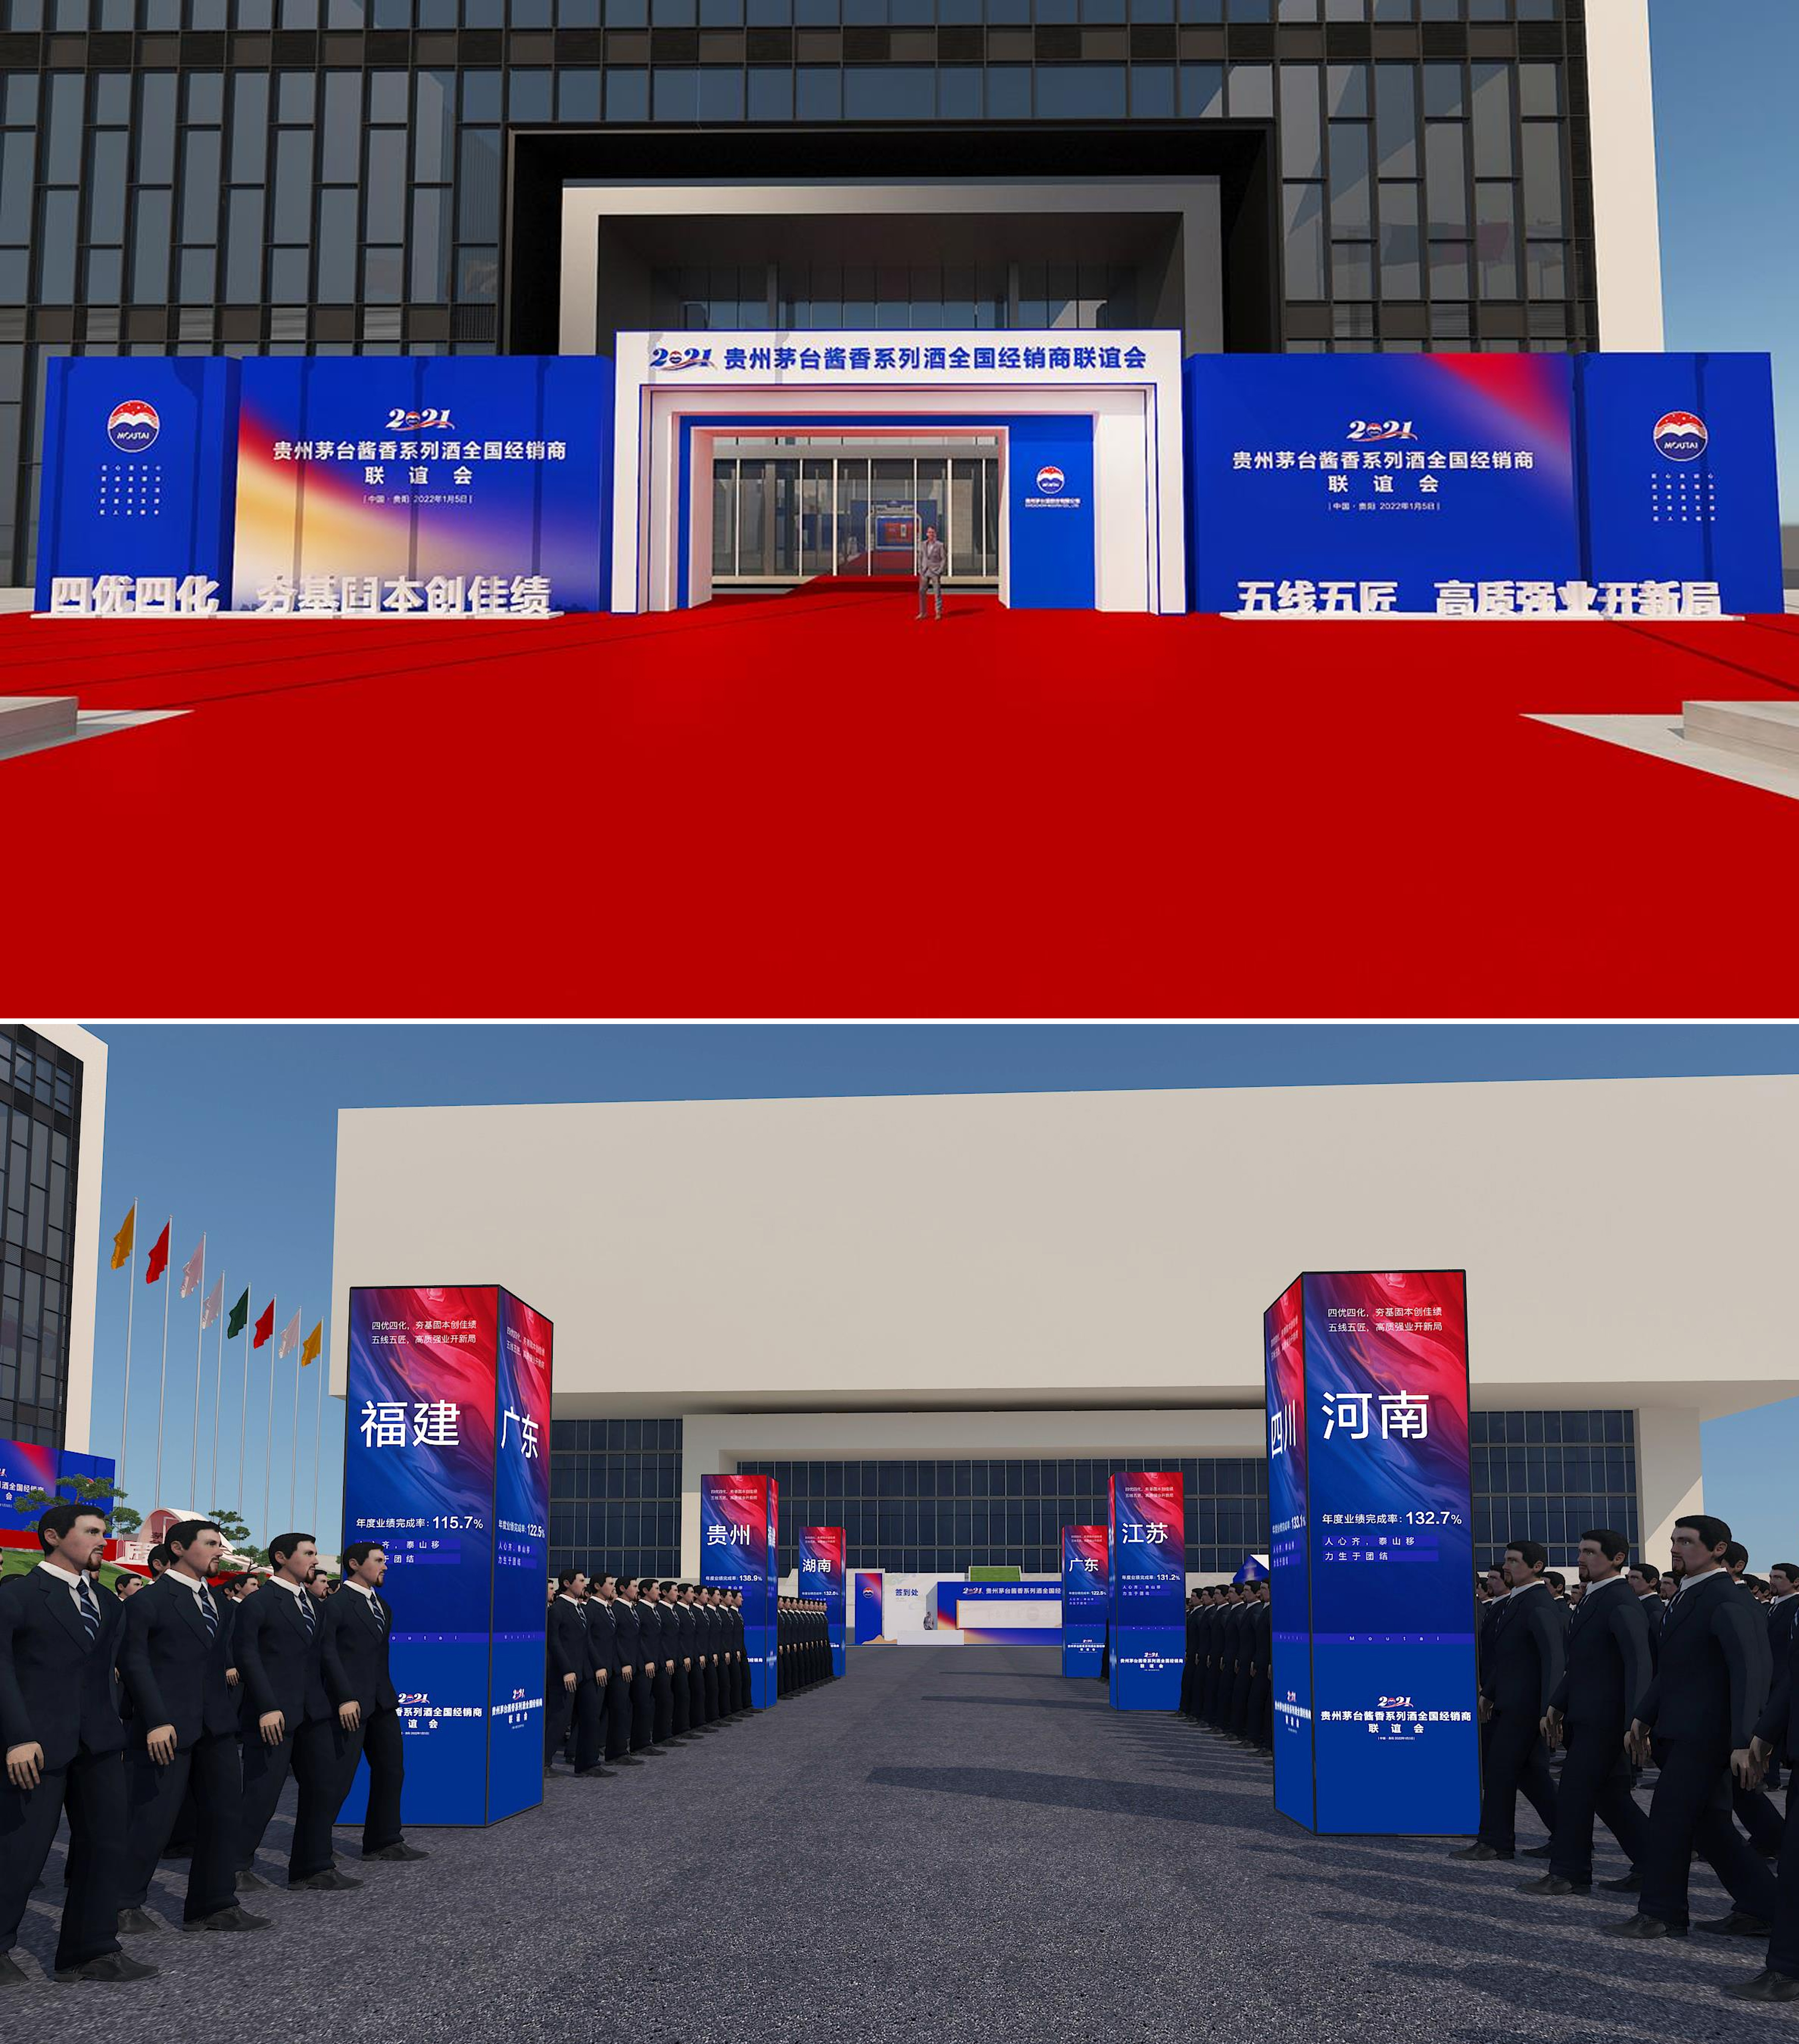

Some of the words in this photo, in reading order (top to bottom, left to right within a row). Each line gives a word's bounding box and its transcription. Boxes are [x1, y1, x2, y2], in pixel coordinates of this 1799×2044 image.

[724, 347, 1146, 370] 贵州茅台酱香系列酒全国经销商联谊会
[117, 432, 149, 440] MOUTAI
[273, 440, 566, 460] 贵州茅台酱香系列酒全国经销商
[1232, 451, 1533, 469] 贵州茅台酱香系列酒全国经销商
[52, 575, 219, 613] 四优四化
[257, 575, 552, 614] 夯基固本创佳绩
[1237, 580, 1398, 615] 五线五匠
[1434, 580, 1722, 615] 高质强业开新局
[1328, 1307, 1442, 1317] 四优四化，夯基固本创佳绩
[372, 1320, 477, 1331] 四优四化，夯基固本创佳绩
[1328, 1321, 1442, 1332] 五线五匠，高质强业开新局
[371, 1334, 476, 1345] 五线五匠，高质强业开新局
[361, 1399, 461, 1447] 福建
[1321, 1390, 1429, 1439] 河南
[501, 1406, 539, 1459] 广东
[1271, 1399, 1296, 1459] 四川
[707, 1525, 750, 1546] 贵州
[1122, 1522, 1168, 1544] 江苏
[803, 1558, 831, 1573] 湖南
[1069, 1558, 1098, 1572] 广东
[1321, 1711, 1471, 1721] 贵州茅台酱香系列酒全国经销商
